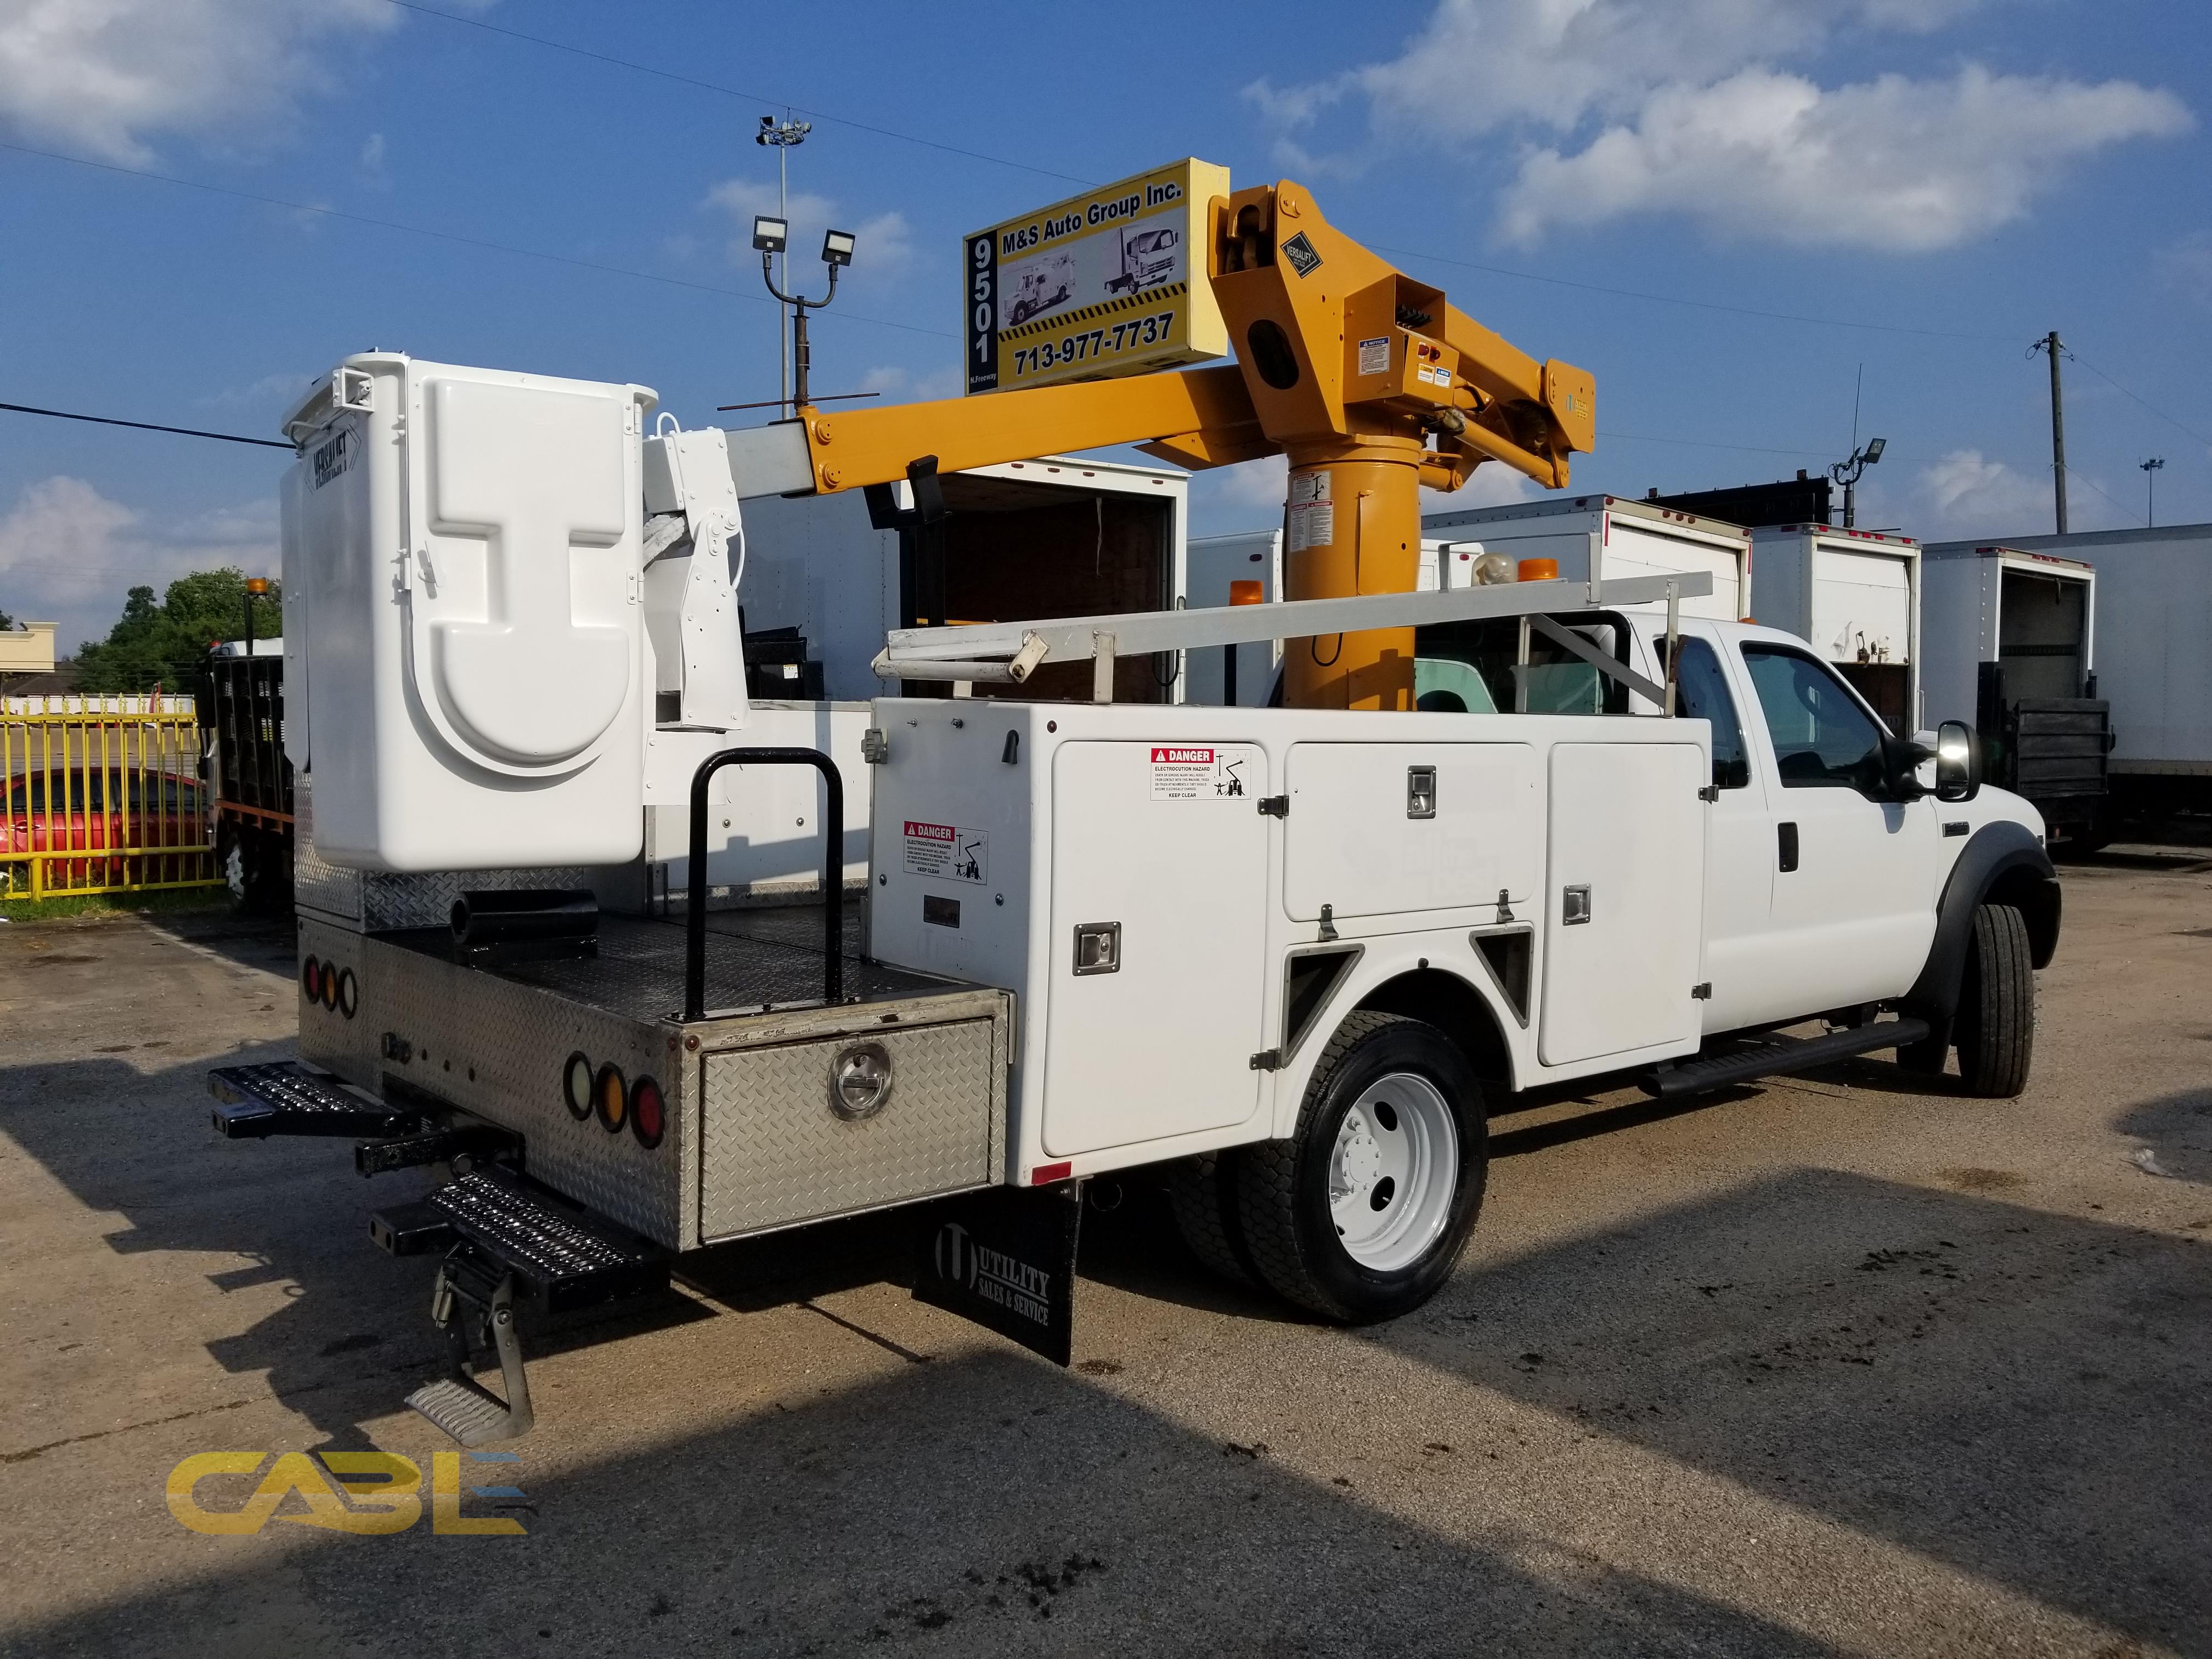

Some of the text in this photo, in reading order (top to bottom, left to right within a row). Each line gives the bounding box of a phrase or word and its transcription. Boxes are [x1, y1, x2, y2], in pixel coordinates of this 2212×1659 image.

[1003, 183, 1181, 255] M&S Auto Group Inc.
[1286, 245, 1311, 263] VERSALIFT
[974, 239, 991, 363] 9501
[1014, 312, 1174, 375] 713-977-7737
[970, 373, 997, 384] N.Freeway
[1169, 750, 1210, 761] DANGER
[918, 825, 951, 839] DANGER
[978, 1245, 1050, 1297] UTILITY
[978, 1278, 1048, 1327] SALES & SERVICE
